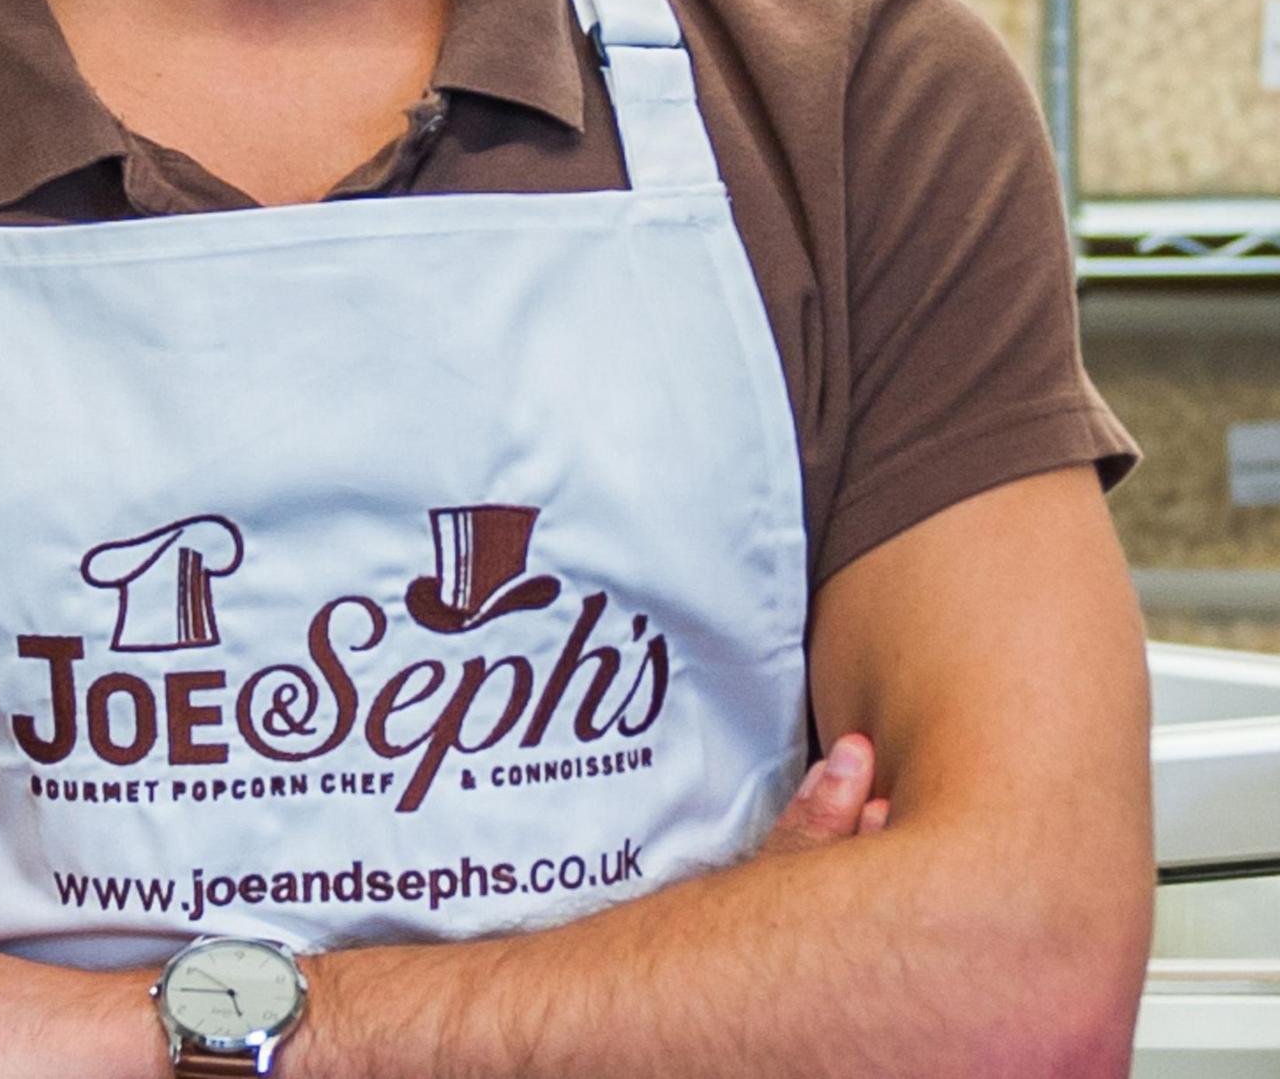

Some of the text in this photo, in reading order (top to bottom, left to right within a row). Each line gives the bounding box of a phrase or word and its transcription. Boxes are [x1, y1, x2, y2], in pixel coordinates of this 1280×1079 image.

[12, 591, 670, 813] JOE & Seph's
[172, 774, 308, 801] POPCORN
[320, 772, 395, 796] CHEF
[460, 769, 477, 790] &
[492, 748, 653, 786] CONNOISSEUR
[53, 837, 643, 921] www.joeandsephs.co.uk
